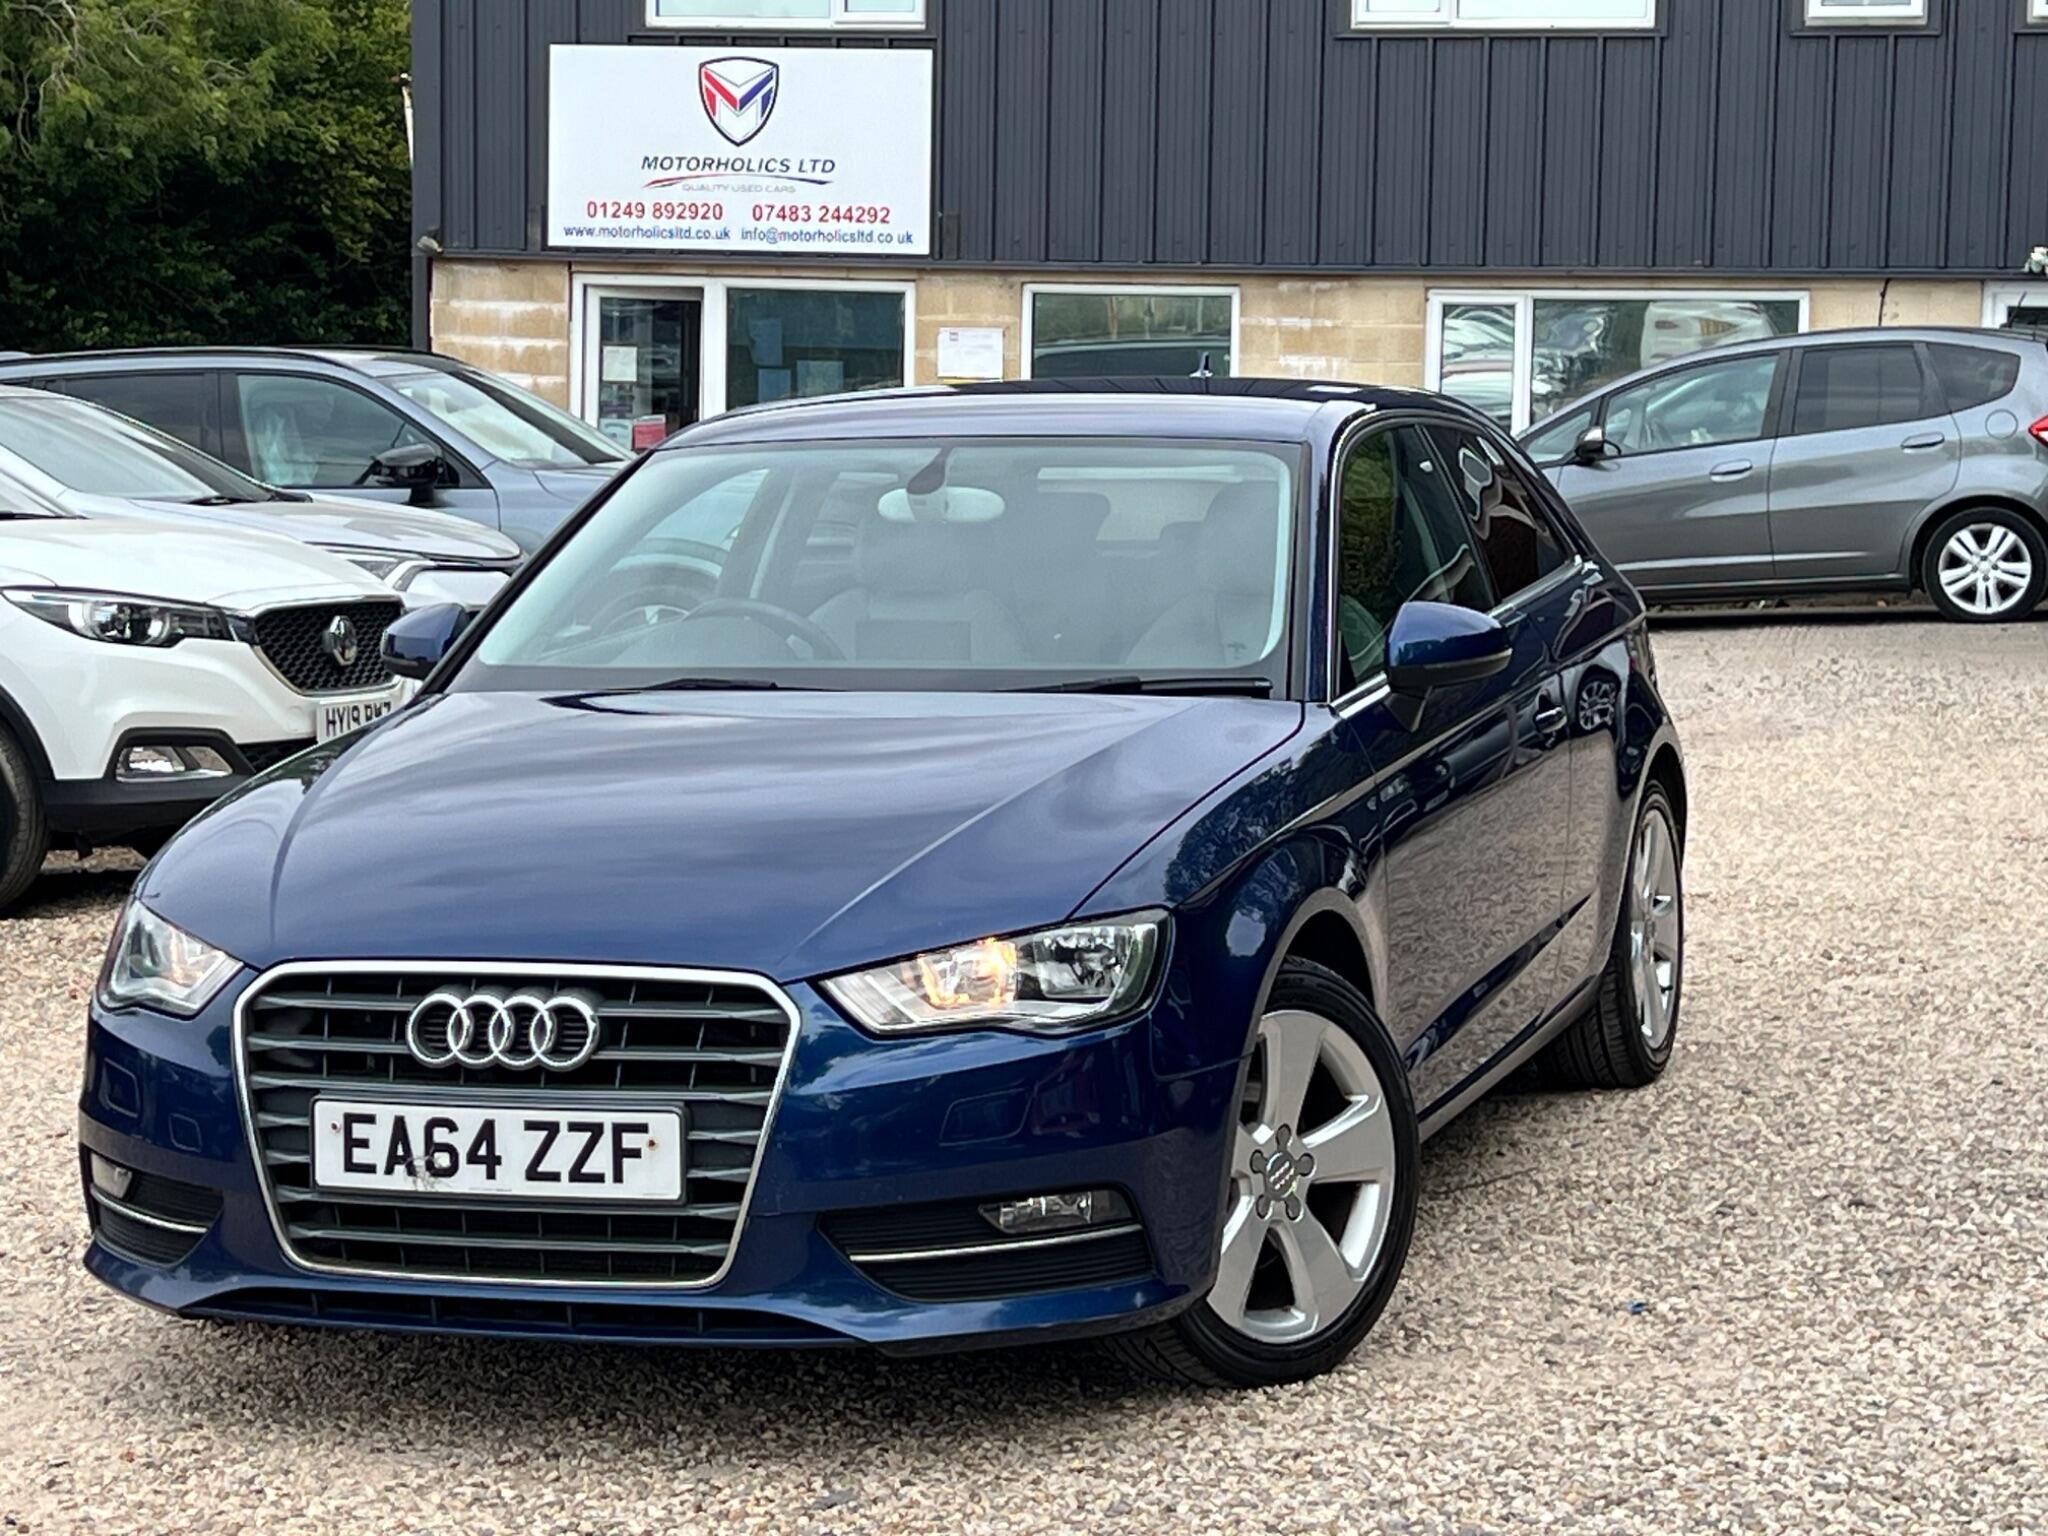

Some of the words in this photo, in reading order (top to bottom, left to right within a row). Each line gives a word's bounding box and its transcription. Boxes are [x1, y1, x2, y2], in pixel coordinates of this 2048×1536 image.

[641, 155, 790, 174] MOTORHOLICS
[798, 159, 835, 174] LTD
[682, 183, 729, 192] QUALITY
[731, 184, 763, 193] USED
[765, 185, 796, 193] CARS
[587, 201, 645, 219] 01249
[652, 202, 723, 221] 892920
[752, 204, 811, 222] 07483
[818, 205, 891, 224] 244292
[563, 225, 731, 241] www.motorholicsltd.co.uk
[741, 227, 913, 245] info@motorholicsltd.couk
[343, 1111, 502, 1180] EA64
[523, 1119, 649, 1184] ZZF
